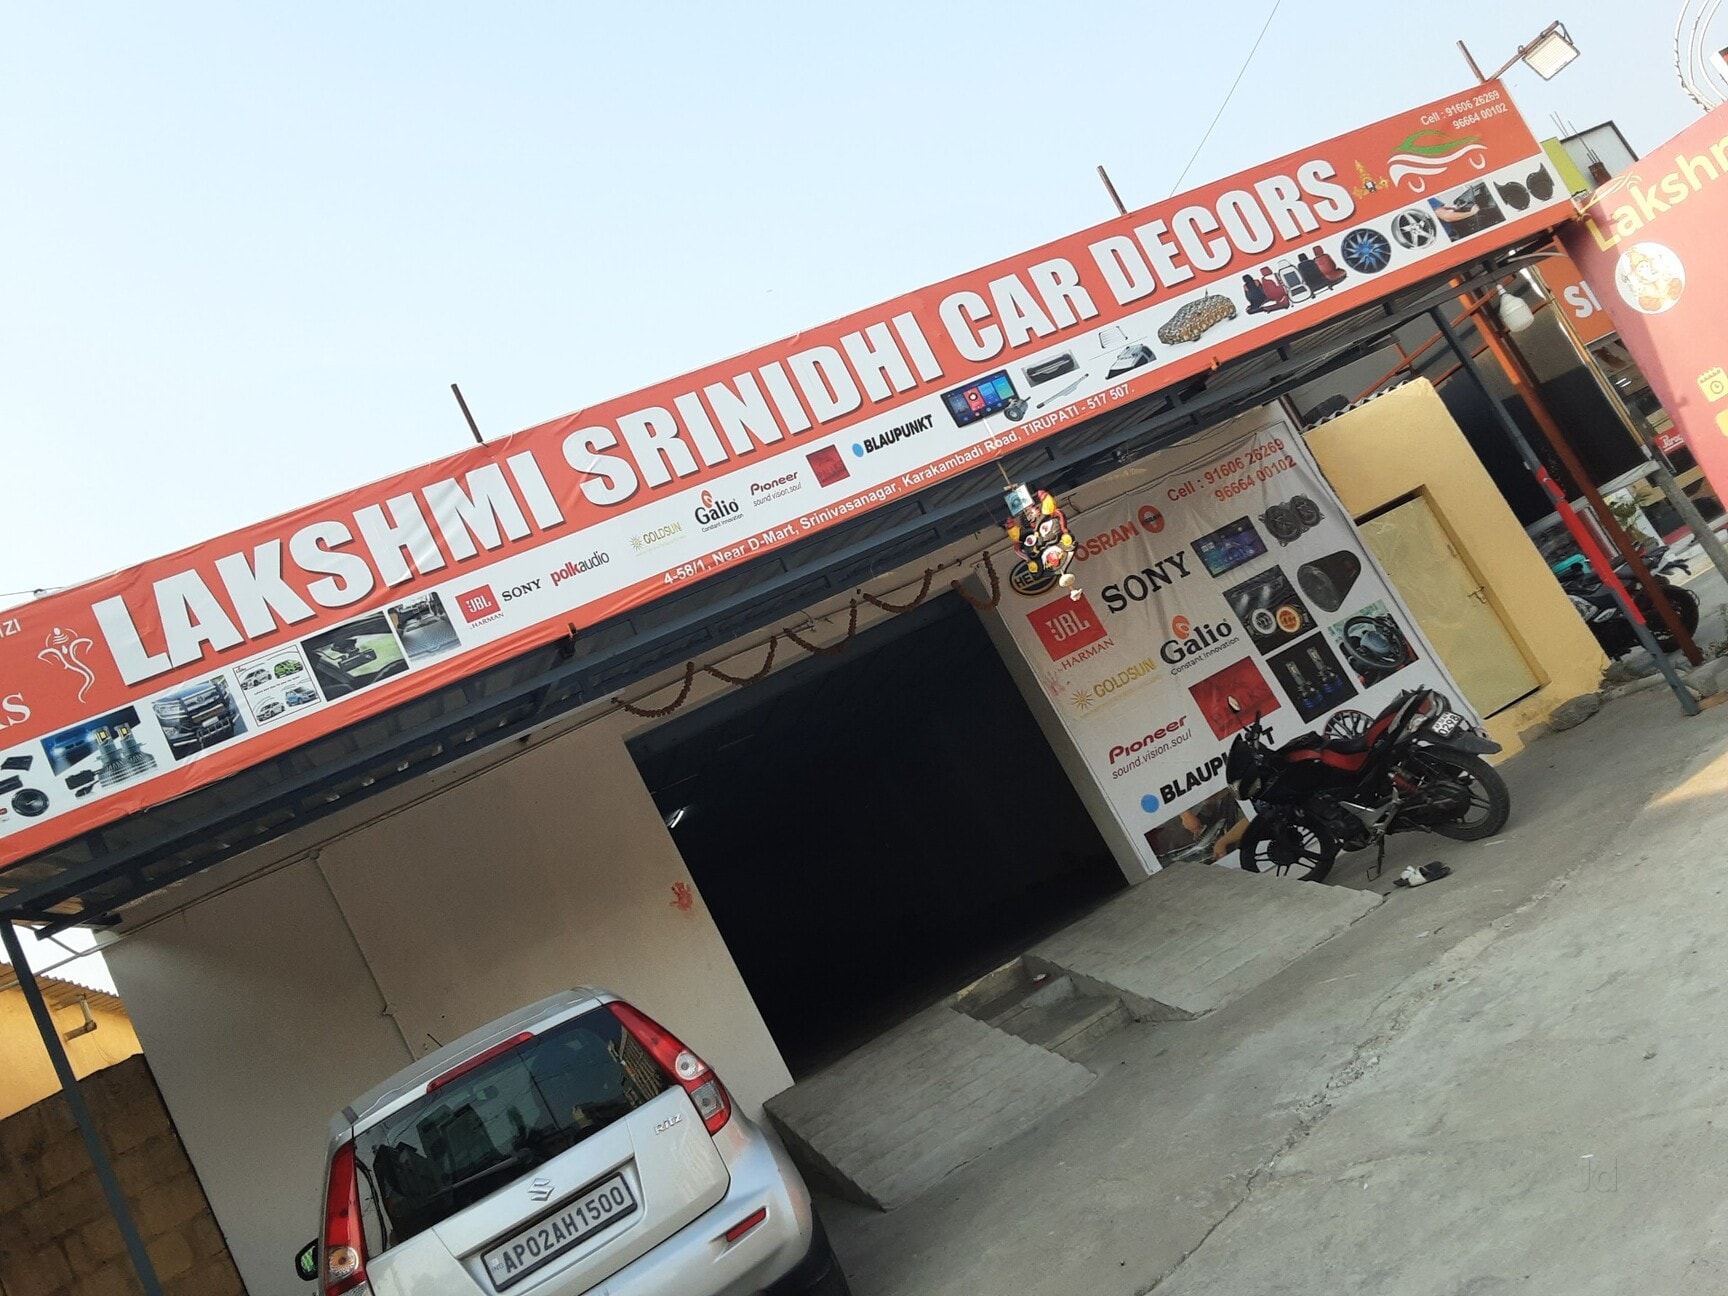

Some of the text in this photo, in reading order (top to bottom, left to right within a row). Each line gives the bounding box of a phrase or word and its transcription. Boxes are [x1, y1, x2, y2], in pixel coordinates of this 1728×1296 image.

[1420, 111, 1441, 126] Cell
[1445, 100, 1474, 117] 91606
[1472, 90, 1501, 107] 26269
[1452, 102, 1509, 130] 96664 00102
[91, 159, 1356, 688] LAKSHMI SRINIDHI CAR DECORS
[863, 413, 935, 454] BLAUPUNKT
[663, 556, 712, 586] 4-58/1,
[714, 542, 746, 566] Near
[749, 524, 800, 553] D-Mart,
[799, 483, 902, 530] Srinivasanagar,
[901, 445, 984, 488] Karakambadi
[984, 430, 1023, 453] Road,
[1020, 406, 1080, 437] TIRUPATI
[1087, 392, 1108, 411] 517
[1108, 383, 1136, 401] 507.
[750, 470, 799, 496] Pioneer
[1167, 481, 1196, 502] Cell
[1203, 456, 1246, 485] 91606
[1244, 438, 1286, 466] 26269
[1213, 454, 1298, 502] 96664 00102
[694, 498, 740, 526] Galio
[642, 521, 682, 545] GOLDSUN
[1073, 520, 1140, 562] OSRAM
[549, 550, 611, 588] polkaudio
[1100, 550, 1192, 615] SONY
[466, 594, 493, 614] JBL
[501, 578, 542, 602] SONY
[0, 618, 21, 639] ZI
[471, 612, 505, 630] HARMAN
[1045, 608, 1092, 643] JBL
[1061, 637, 1116, 673] HARMAN
[1159, 620, 1233, 666] Galio
[1169, 635, 1241, 678] Constant Innovation
[1093, 656, 1158, 700] GOLDSUN
[1108, 714, 1188, 765] Pioneer
[1438, 714, 1460, 737] 0298
[1111, 727, 1193, 781] sound.vision.soul
[1159, 725, 1276, 805] BLAUPT
[502, 1184, 626, 1274] AP02AH1500
